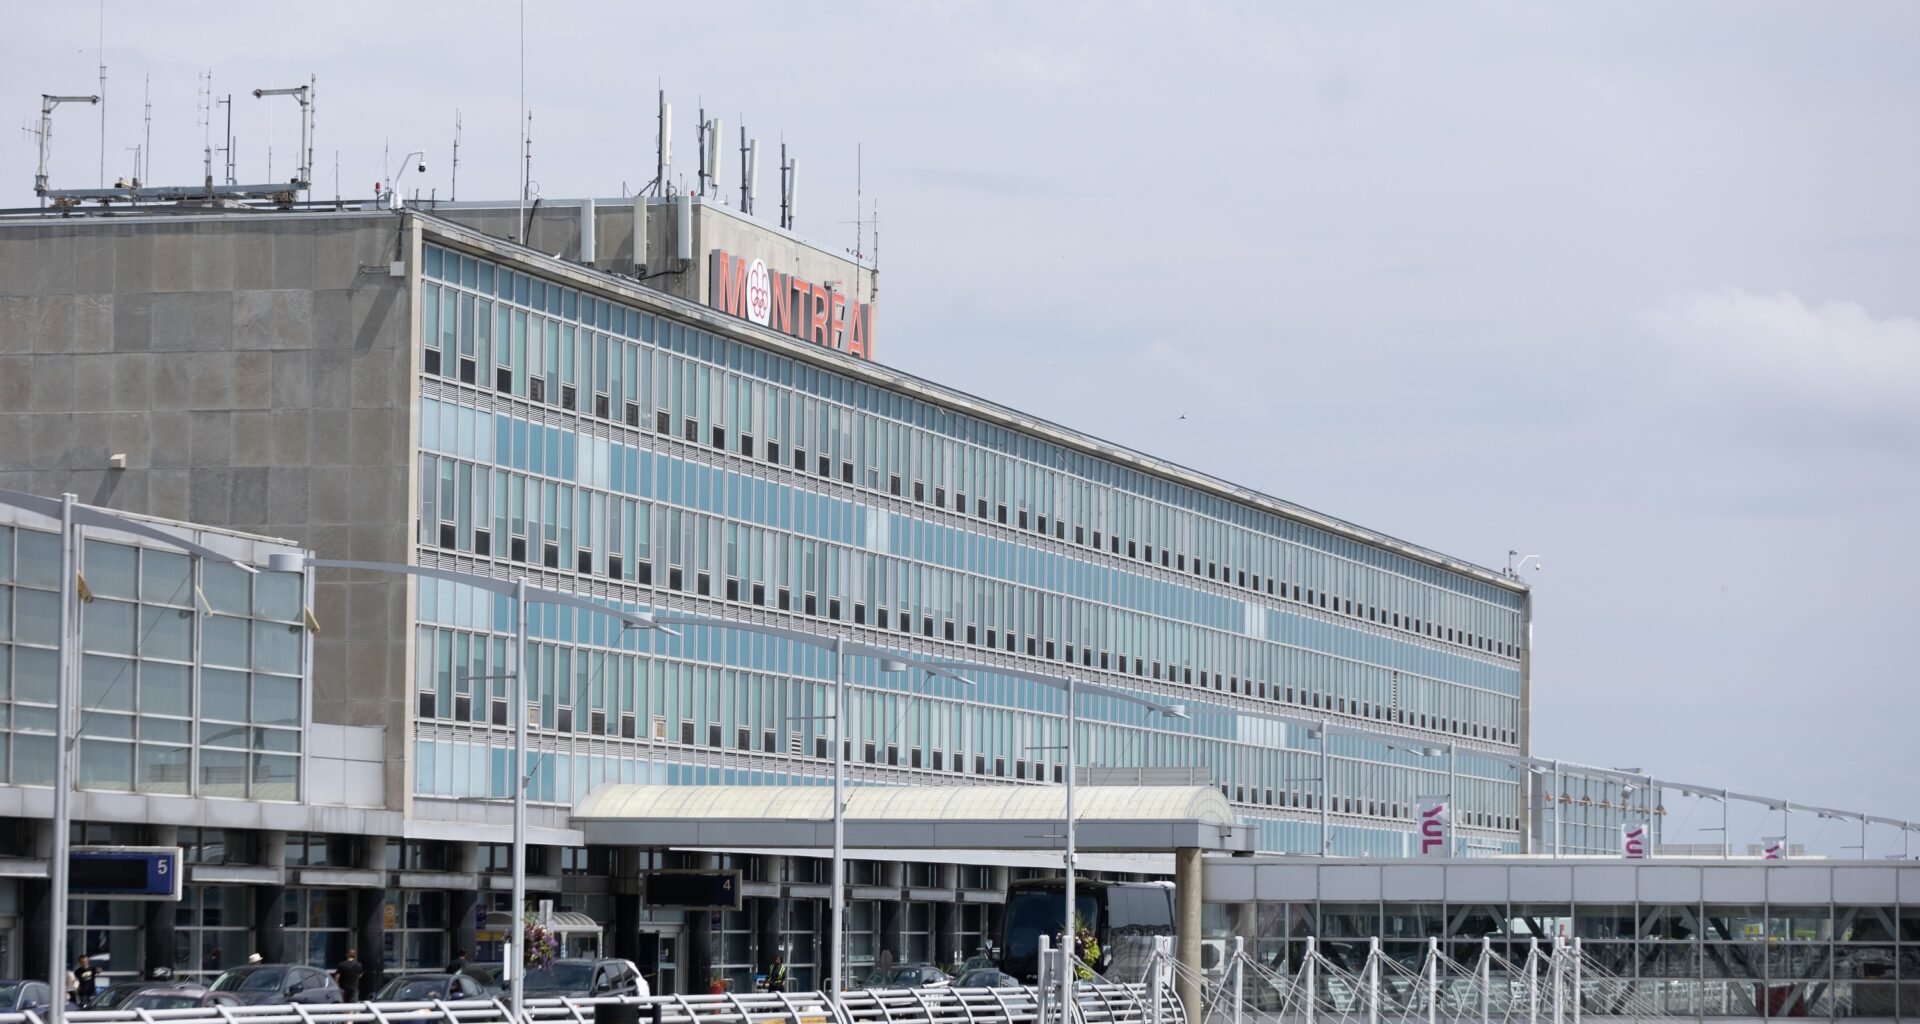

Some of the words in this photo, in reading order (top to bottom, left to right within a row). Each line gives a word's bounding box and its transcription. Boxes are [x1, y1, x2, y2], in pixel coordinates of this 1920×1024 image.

[1421, 804, 1443, 854] YUL
[157, 859, 168, 875] 5
[723, 879, 732, 891] 4
